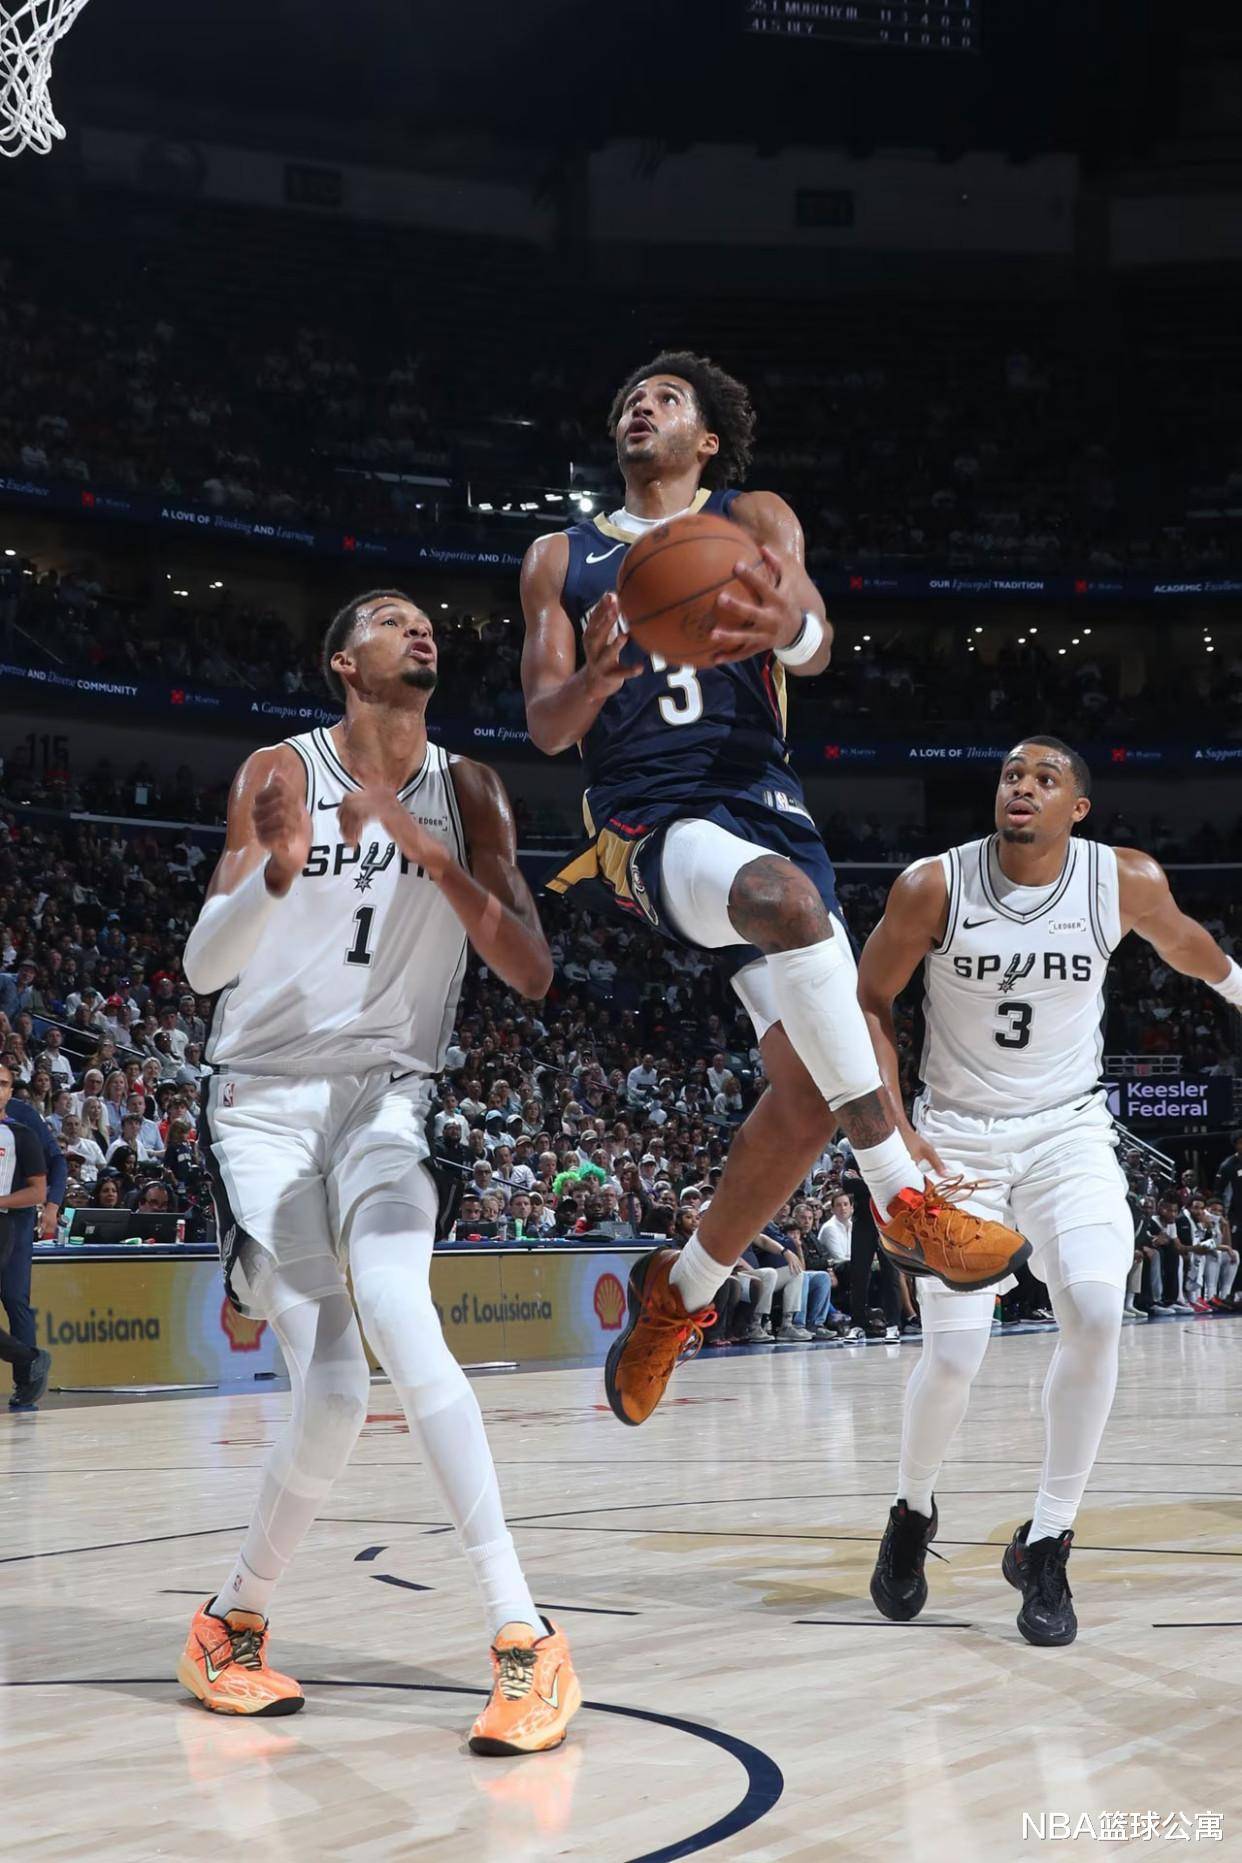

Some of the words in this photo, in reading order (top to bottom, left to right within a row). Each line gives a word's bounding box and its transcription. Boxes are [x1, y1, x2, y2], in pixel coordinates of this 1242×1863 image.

[161, 508, 169, 518] A
[171, 510, 194, 522] LOVE
[197, 514, 210, 525] OF
[253, 524, 274, 536] AND
[419, 548, 427, 557] A
[478, 553, 499, 562] AND
[929, 580, 950, 589] OUR
[993, 580, 1044, 589] TRADITION
[1154, 583, 1202, 593] ACADEMIC
[27, 669, 46, 681] AND
[77, 679, 138, 696] COMMUNITY
[651, 652, 703, 726] 3
[251, 702, 259, 712] A
[299, 708, 312, 718] OF
[313, 707, 344, 724] Oppor
[473, 727, 495, 737] OUR
[497, 726, 529, 742] Episcop
[909, 748, 917, 758] A
[919, 748, 946, 758] LOVE
[948, 748, 963, 758] OF
[1195, 750, 1203, 758] A
[418, 817, 443, 826] EDGER
[1053, 921, 1082, 931] LEDGER
[343, 904, 376, 968] 1
[953, 952, 1092, 993] SPURS
[993, 1000, 1033, 1050] 3
[1127, 1081, 1208, 1098] Keesler
[1128, 1100, 1208, 1117] Federal
[451, 1293, 469, 1324] of
[473, 1293, 552, 1323] Louisiana
[46, 1308, 160, 1345] Louisiana
